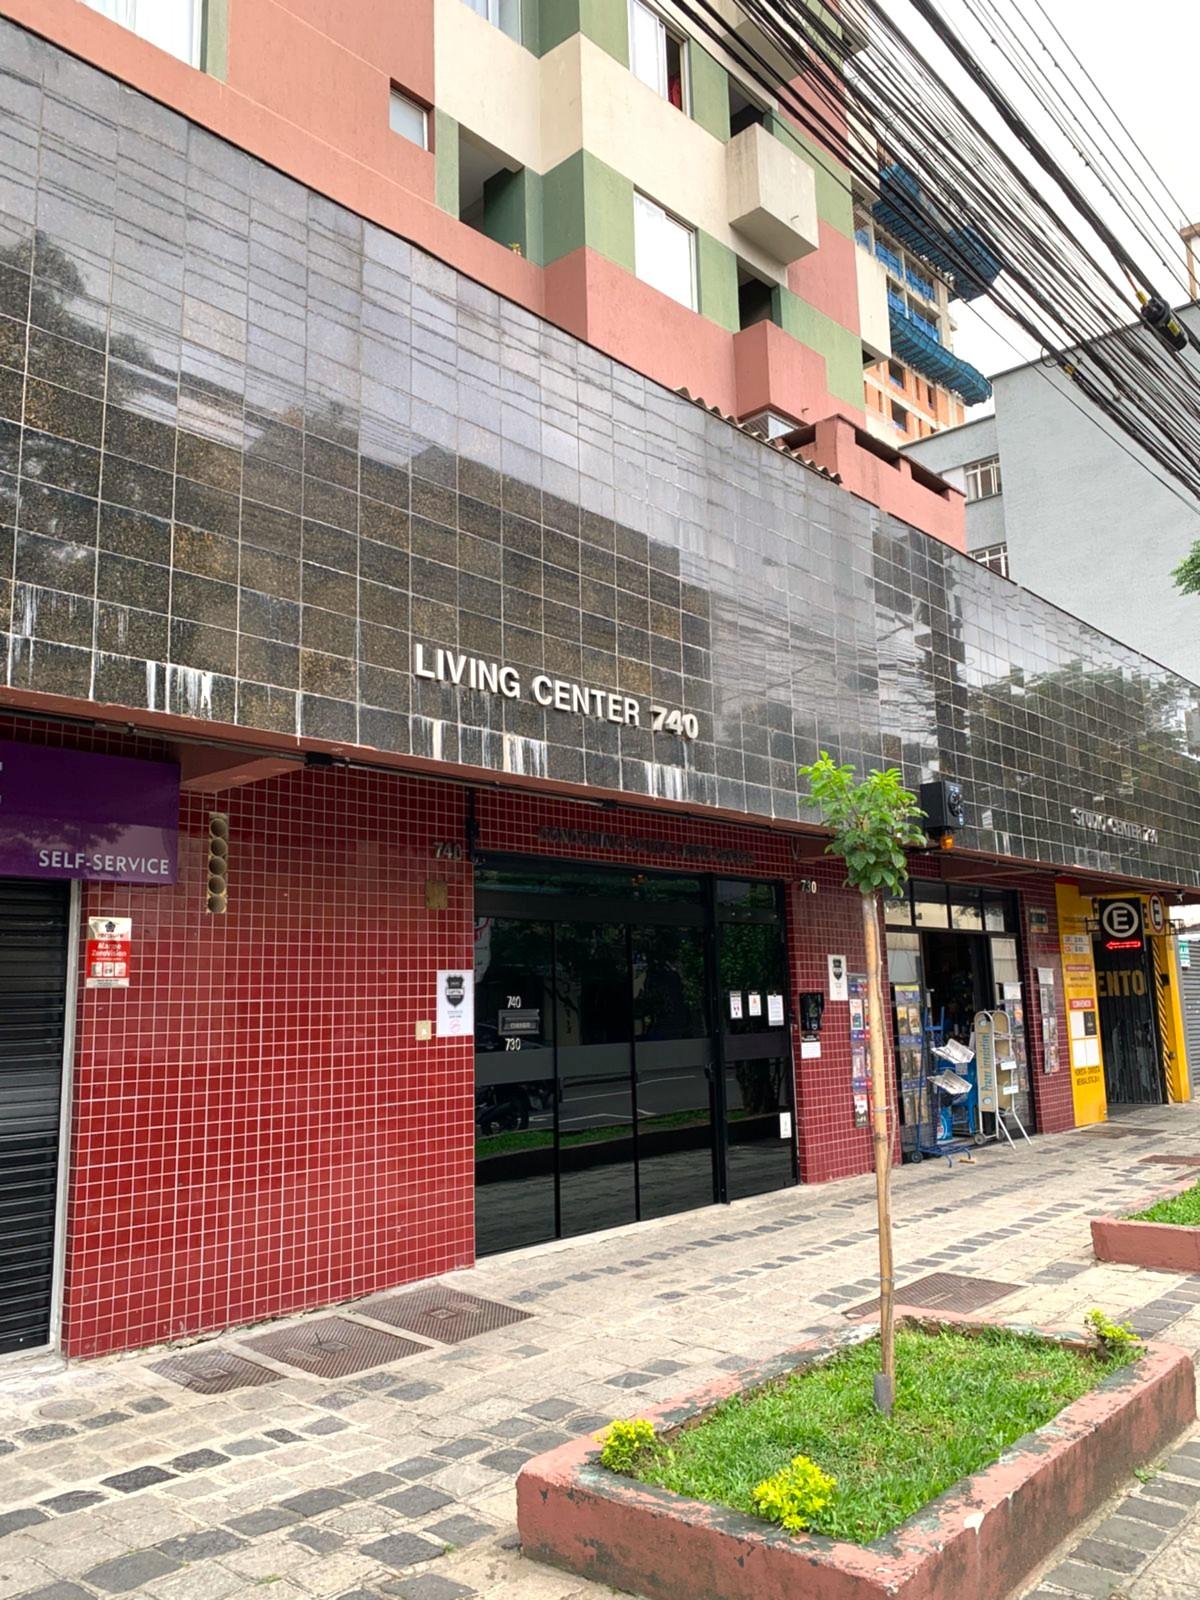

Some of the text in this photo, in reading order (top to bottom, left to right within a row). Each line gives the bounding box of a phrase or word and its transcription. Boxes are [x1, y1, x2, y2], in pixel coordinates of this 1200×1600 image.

[415, 643, 700, 740] LIVING CENTER 740
[432, 841, 463, 861] 740
[38, 849, 170, 876] SELF-SERVICE
[800, 879, 818, 894] 730
[507, 995, 522, 1009] 740
[505, 1038, 521, 1052] 730
